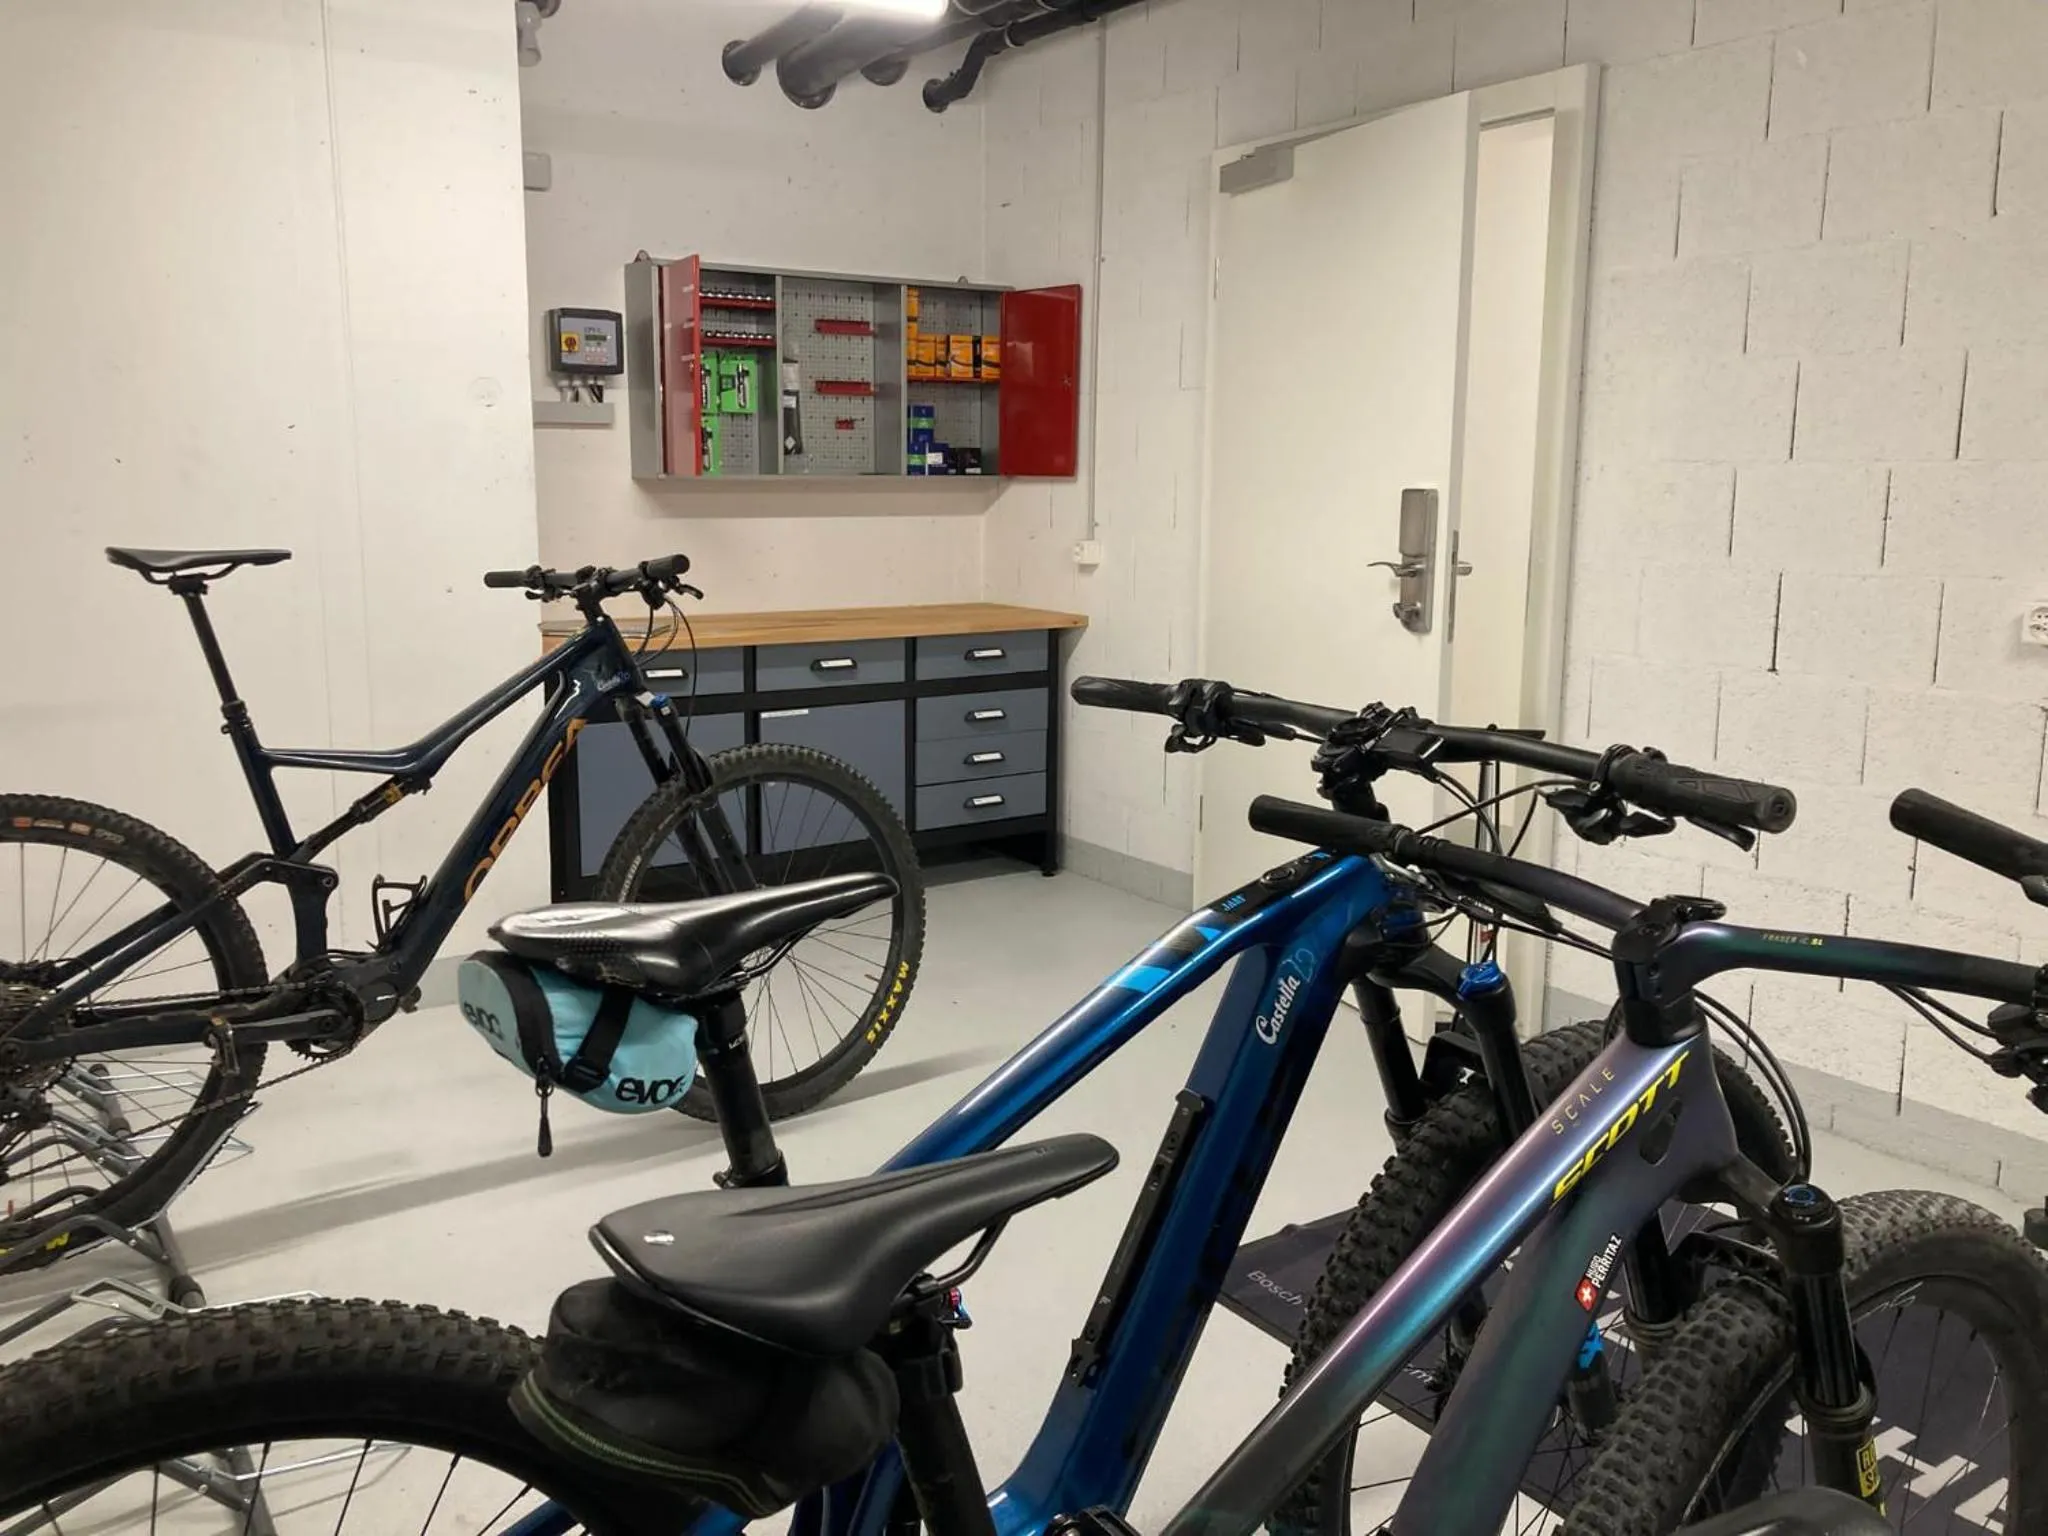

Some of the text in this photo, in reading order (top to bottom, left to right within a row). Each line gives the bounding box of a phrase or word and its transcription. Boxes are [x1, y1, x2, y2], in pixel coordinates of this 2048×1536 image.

[866, 960, 909, 1043] MAXXIS
[1256, 972, 1302, 1045] Castella
[1550, 1050, 1690, 1210] SCOTT
[1551, 1067, 1615, 1134] SCALE
[1591, 1234, 1622, 1289] PERRITAZ
